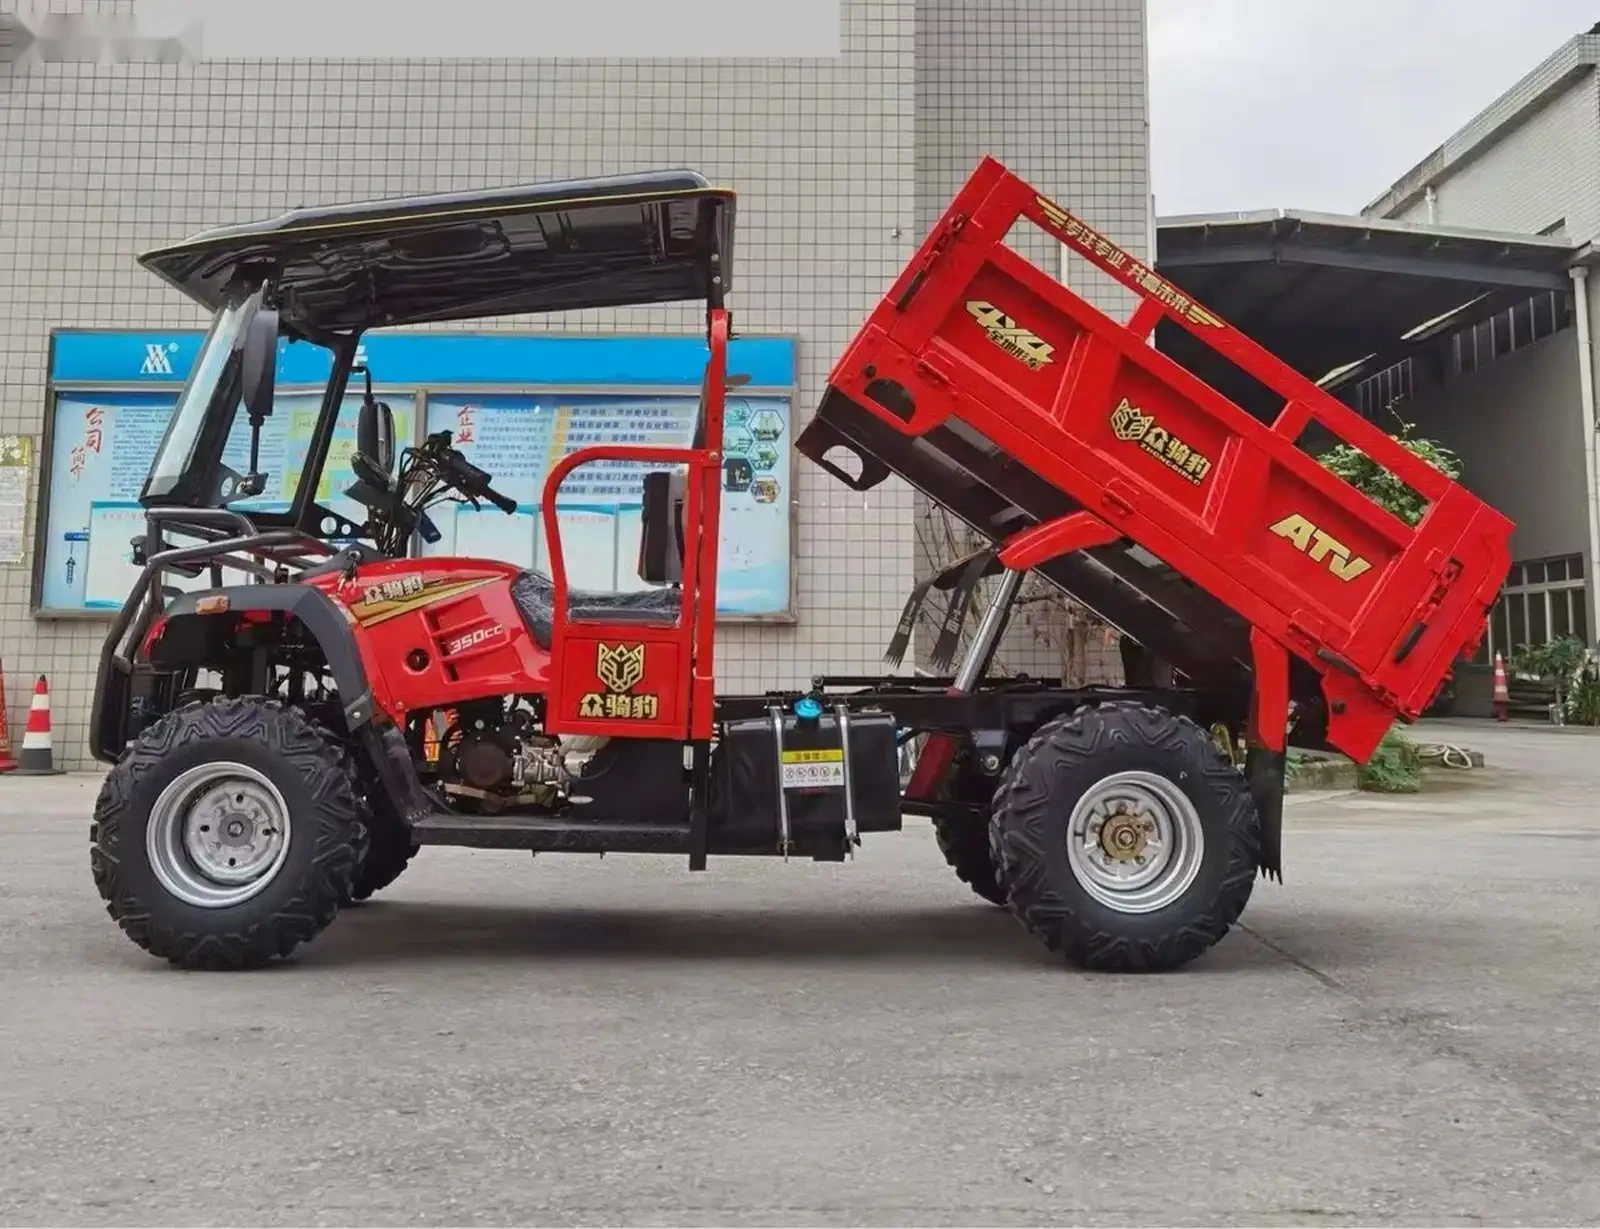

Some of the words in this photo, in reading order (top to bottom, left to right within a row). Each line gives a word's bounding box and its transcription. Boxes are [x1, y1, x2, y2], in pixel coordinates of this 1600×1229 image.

[1065, 219, 1127, 269] 专注专业
[85, 407, 105, 453] 公司
[457, 406, 475, 444] 企业
[1143, 427, 1212, 480] 众骑豹
[1268, 513, 1373, 582] ATV
[449, 624, 503, 655] 350cc
[579, 693, 658, 719] 众骑豹
